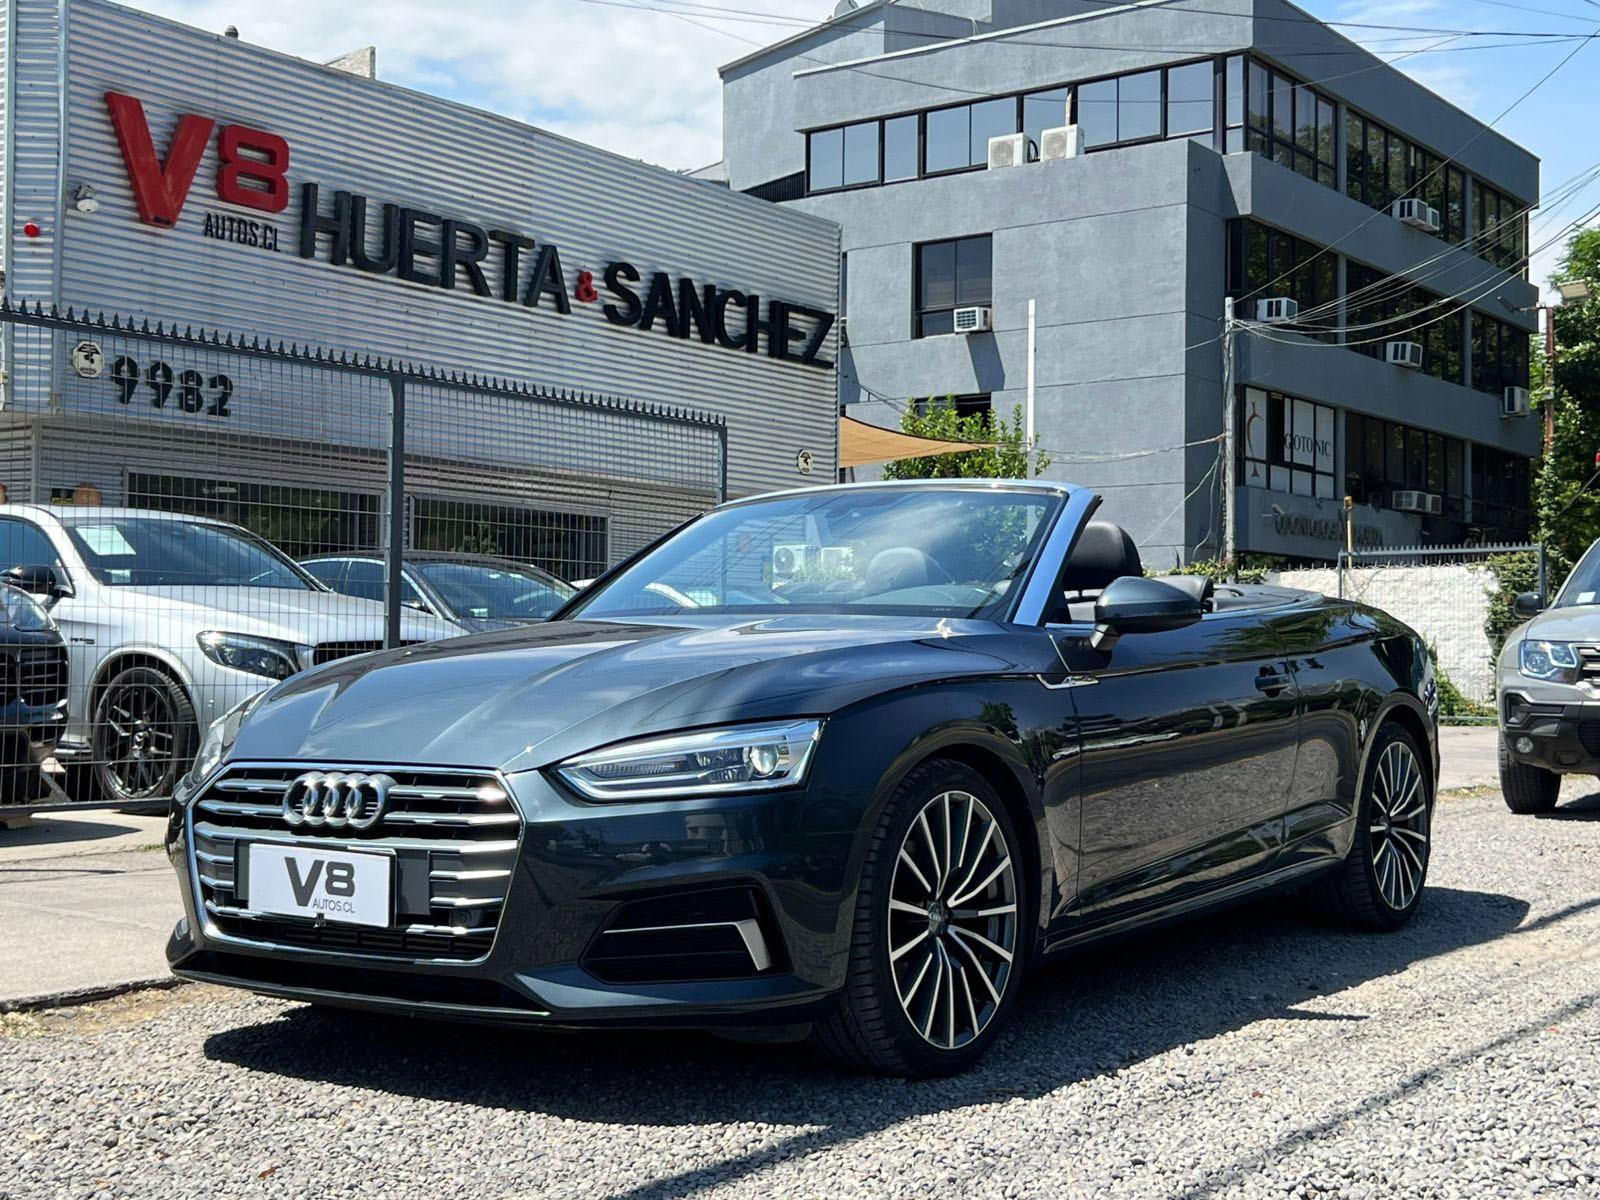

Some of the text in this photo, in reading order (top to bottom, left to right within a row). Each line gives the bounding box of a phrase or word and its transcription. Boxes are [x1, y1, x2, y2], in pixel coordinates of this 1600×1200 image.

[104, 91, 290, 229] V8
[203, 212, 281, 253] AUTOS.CL
[301, 182, 836, 369] HUERTA & SANCHEZ
[111, 355, 234, 417] 9982
[284, 856, 356, 907] V8
[312, 898, 355, 914] AUTOS.CL
